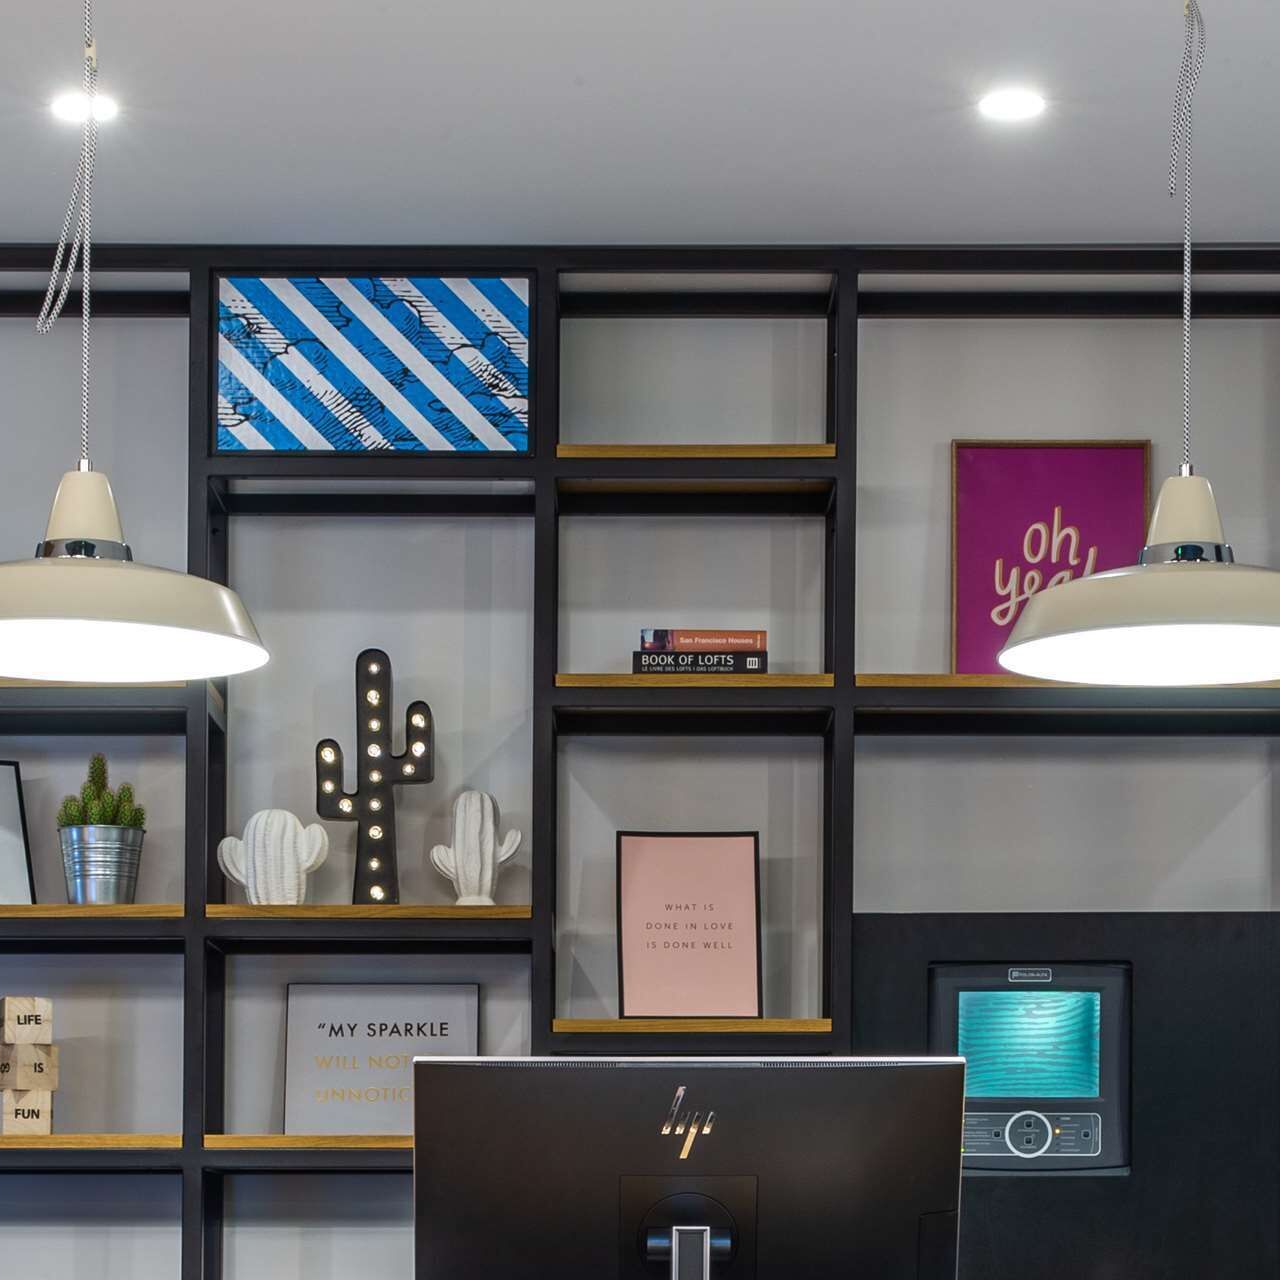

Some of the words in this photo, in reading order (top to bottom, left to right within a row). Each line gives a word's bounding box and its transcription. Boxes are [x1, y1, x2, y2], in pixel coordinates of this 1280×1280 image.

[1023, 506, 1080, 566] oh
[641, 655, 675, 665] BOOK
[678, 655, 694, 665] OF
[698, 655, 734, 665] LOFTS
[645, 922, 679, 930] DONE
[685, 922, 697, 930] IN
[703, 922, 733, 930] LOVE
[646, 941, 657, 949] IS
[663, 941, 696, 949] DONE
[703, 941, 733, 949] WELL
[16, 1014, 42, 1026] LIFE
[367, 1022, 449, 1037] SPARKLE
[33, 1062, 44, 1073] IS
[314, 1055, 360, 1070] WILL
[368, 1055, 410, 1070] NOT
[314, 1087, 411, 1104] UNNOTIC
[14, 1108, 40, 1120] FUN
